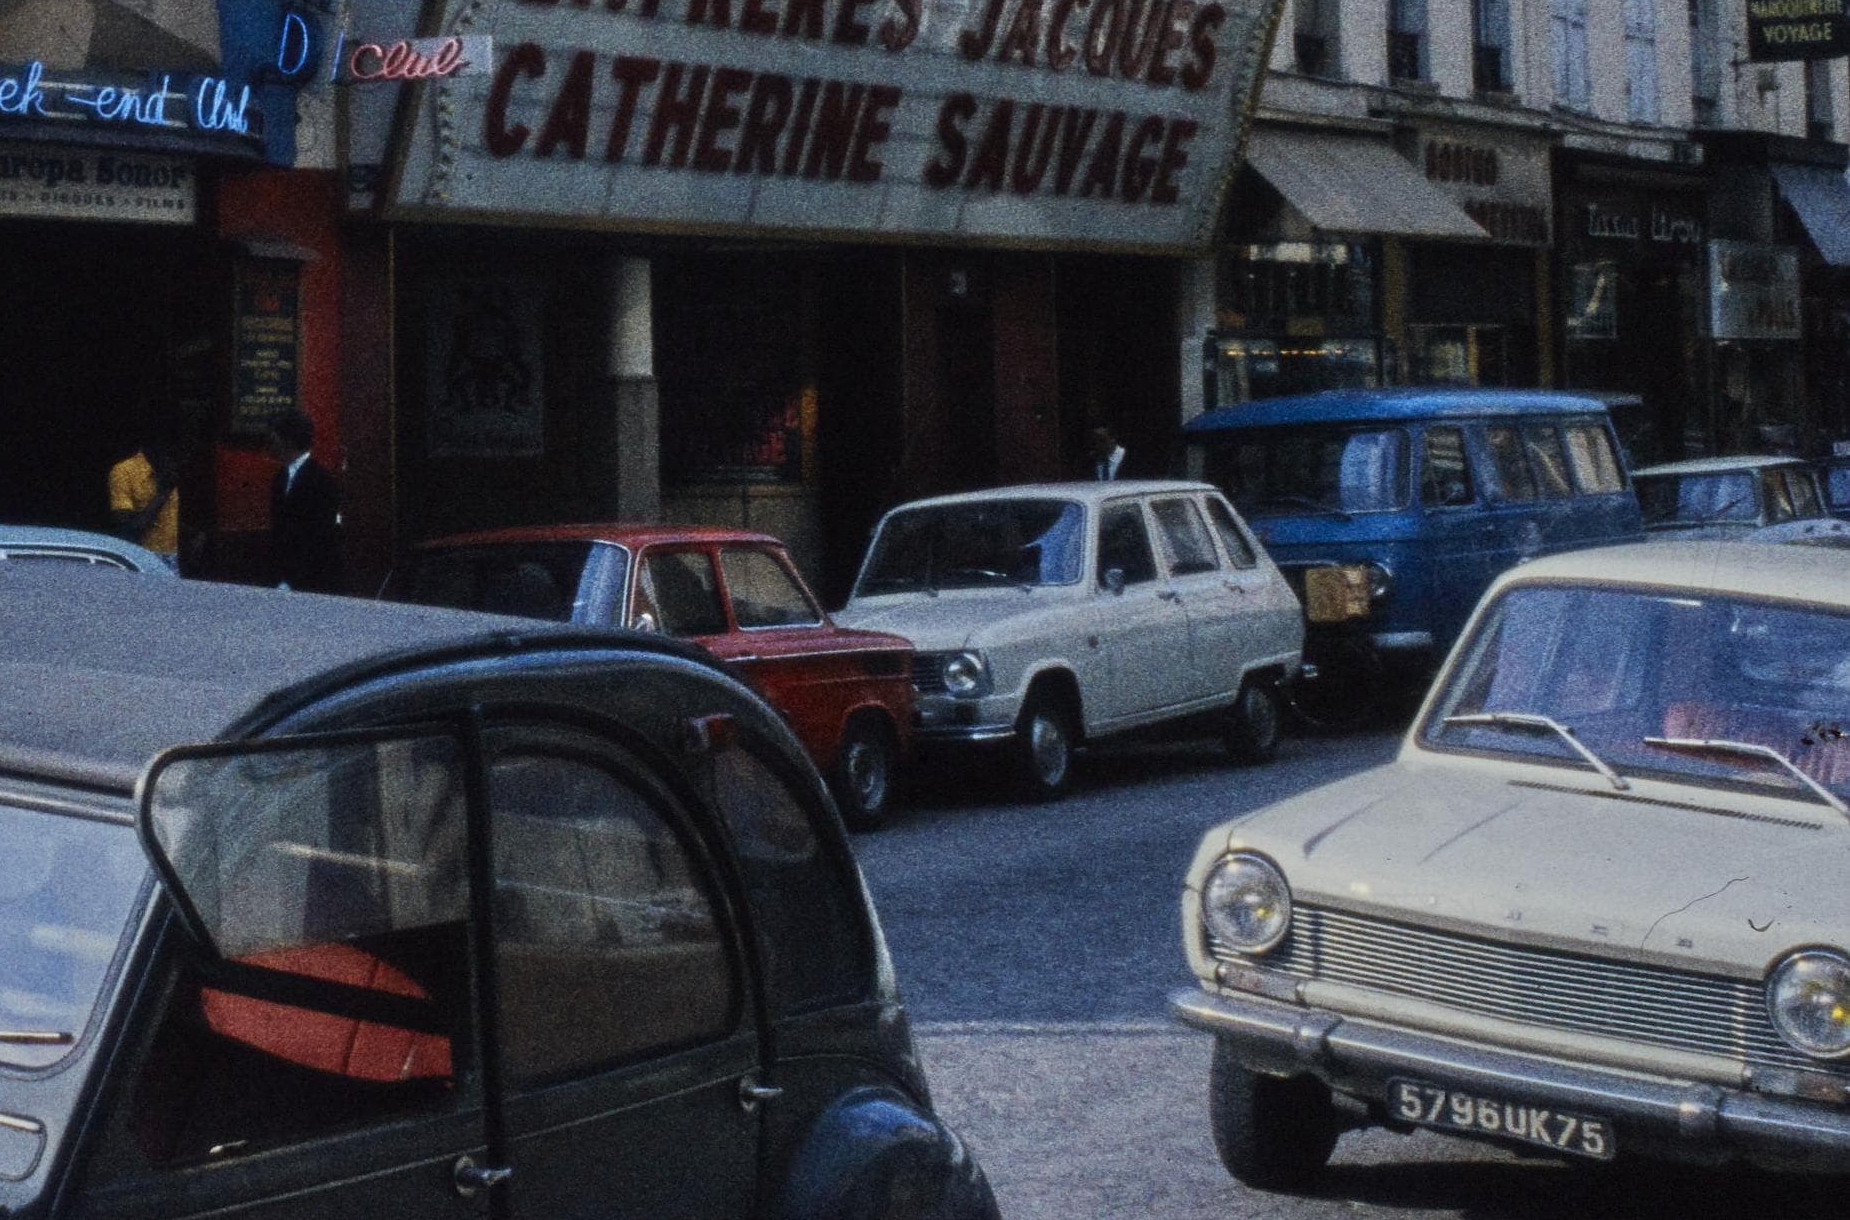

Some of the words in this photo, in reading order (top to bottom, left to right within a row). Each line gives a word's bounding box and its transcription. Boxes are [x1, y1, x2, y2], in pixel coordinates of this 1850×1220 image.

[1762, 21, 1833, 44] VOYAGE
[485, 43, 901, 182] CATHERINE
[930, 90, 1200, 204] SAUVAGE
[96, 156, 186, 189] Sonor
[1399, 1083, 1607, 1156] 5796UK75
